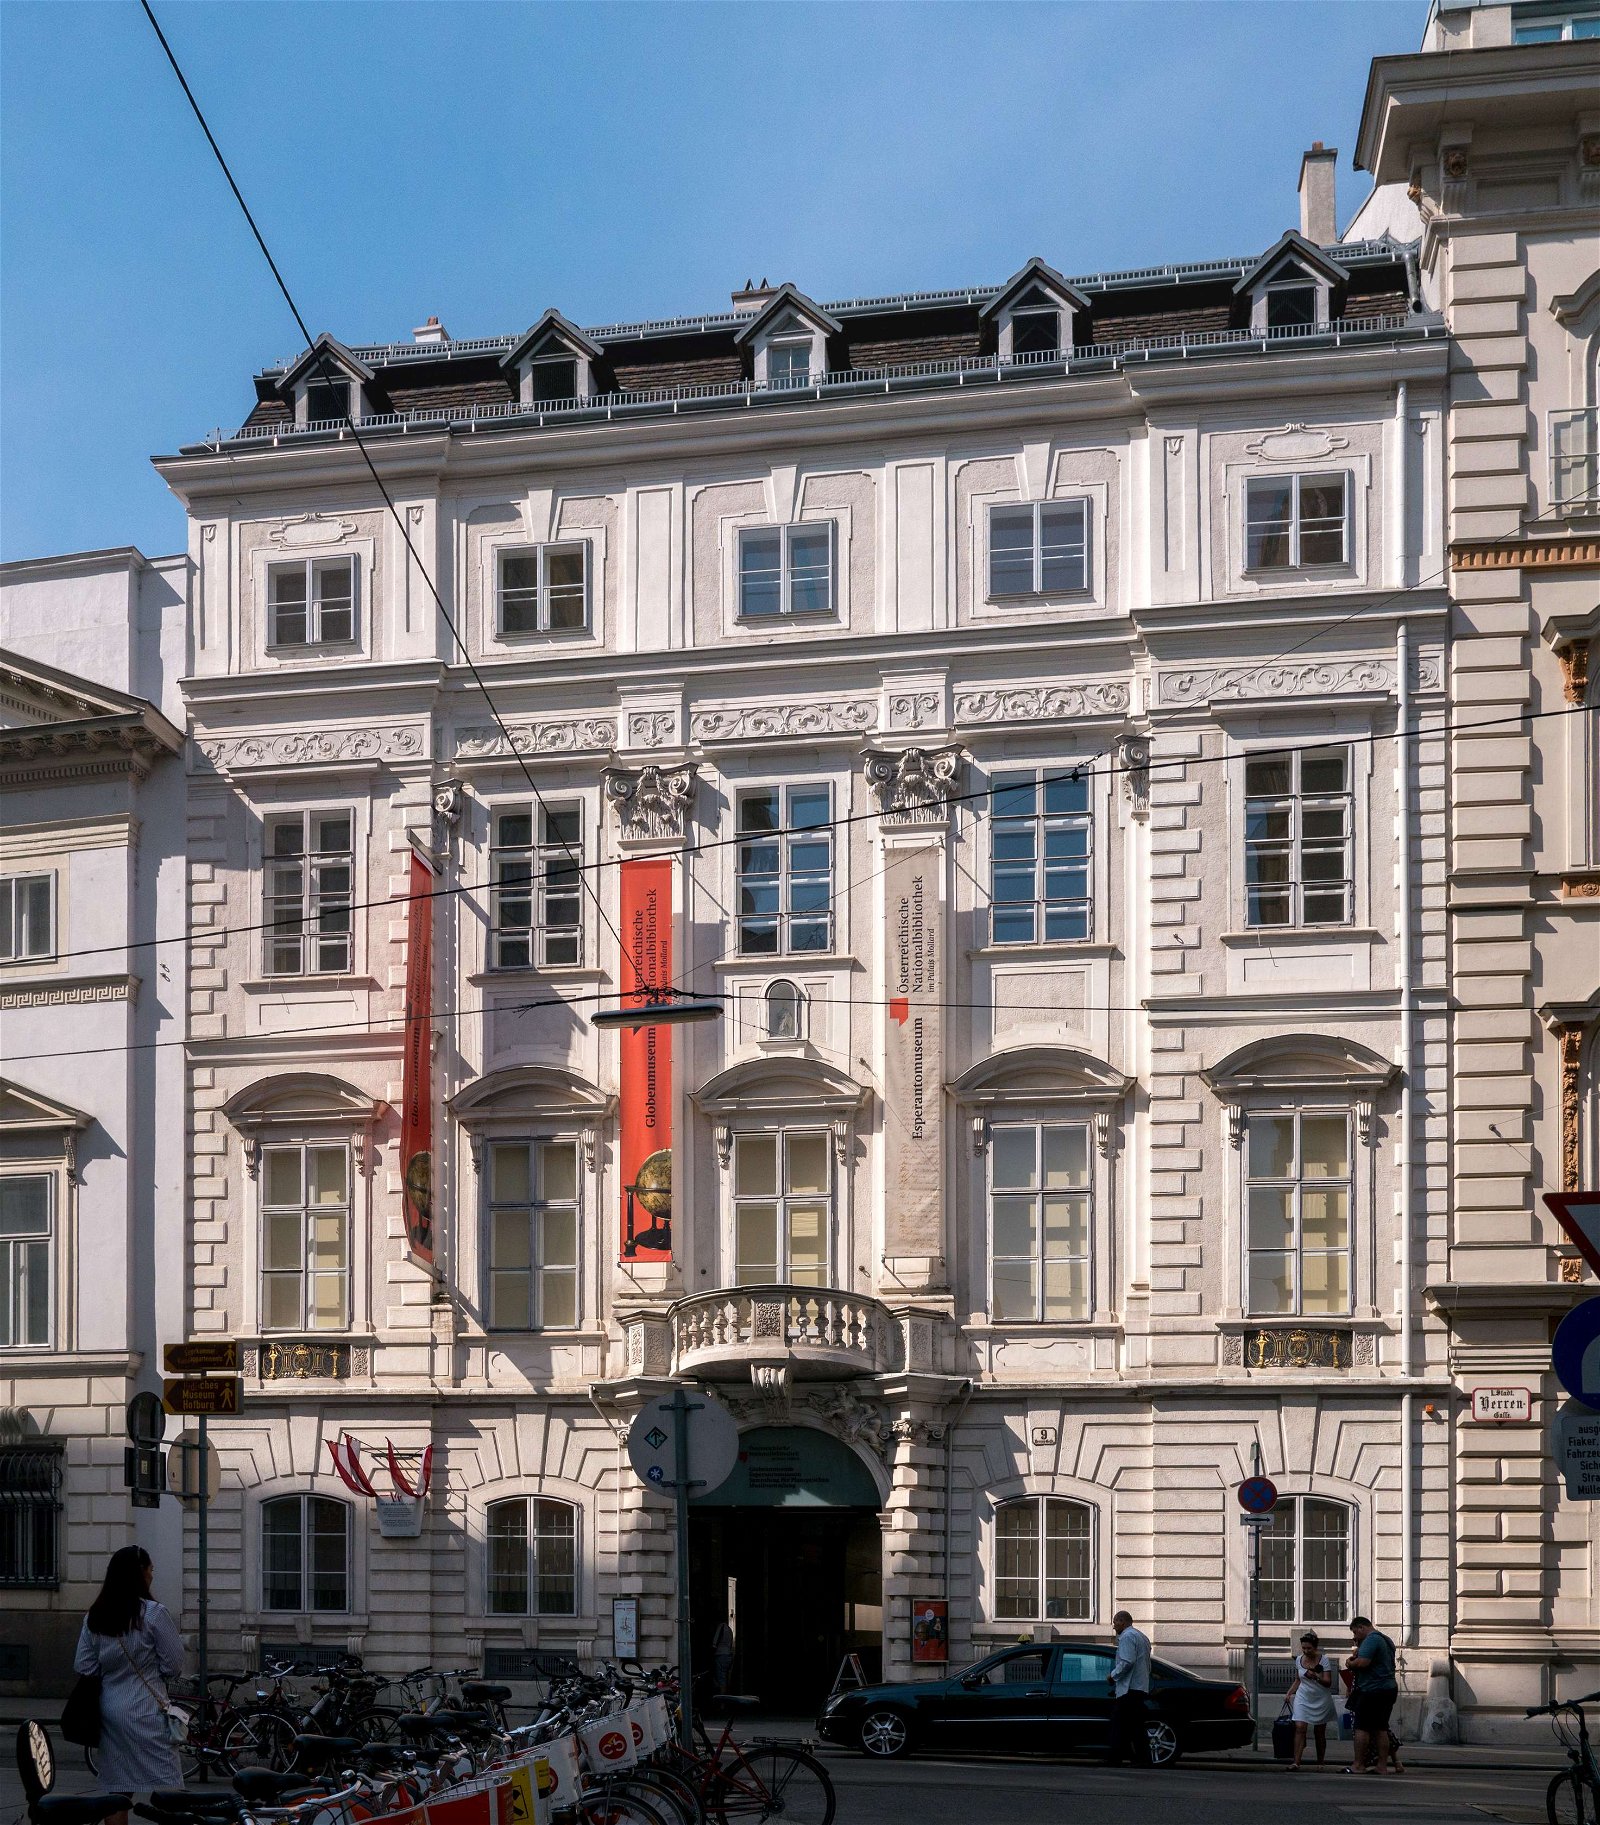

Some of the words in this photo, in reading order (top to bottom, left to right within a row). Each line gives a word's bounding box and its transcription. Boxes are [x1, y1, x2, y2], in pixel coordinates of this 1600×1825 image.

[646, 888, 656, 1003] Ntionalbibliothek
[896, 897, 909, 994] Österreichische
[912, 875, 923, 993] Nationalbibliothek
[927, 928, 935, 957] Mollard
[660, 940, 668, 969] Mollard
[927, 959, 935, 981] Palais
[645, 1027, 656, 1128] Globenmuseum
[912, 1017, 925, 1140] Esperantomuseum
[182, 1389, 215, 1399] Museum
[182, 1399, 215, 1411] Hofburg
[1040, 1429, 1048, 1440] 9
[1580, 1460, 1600, 1470] Sich
